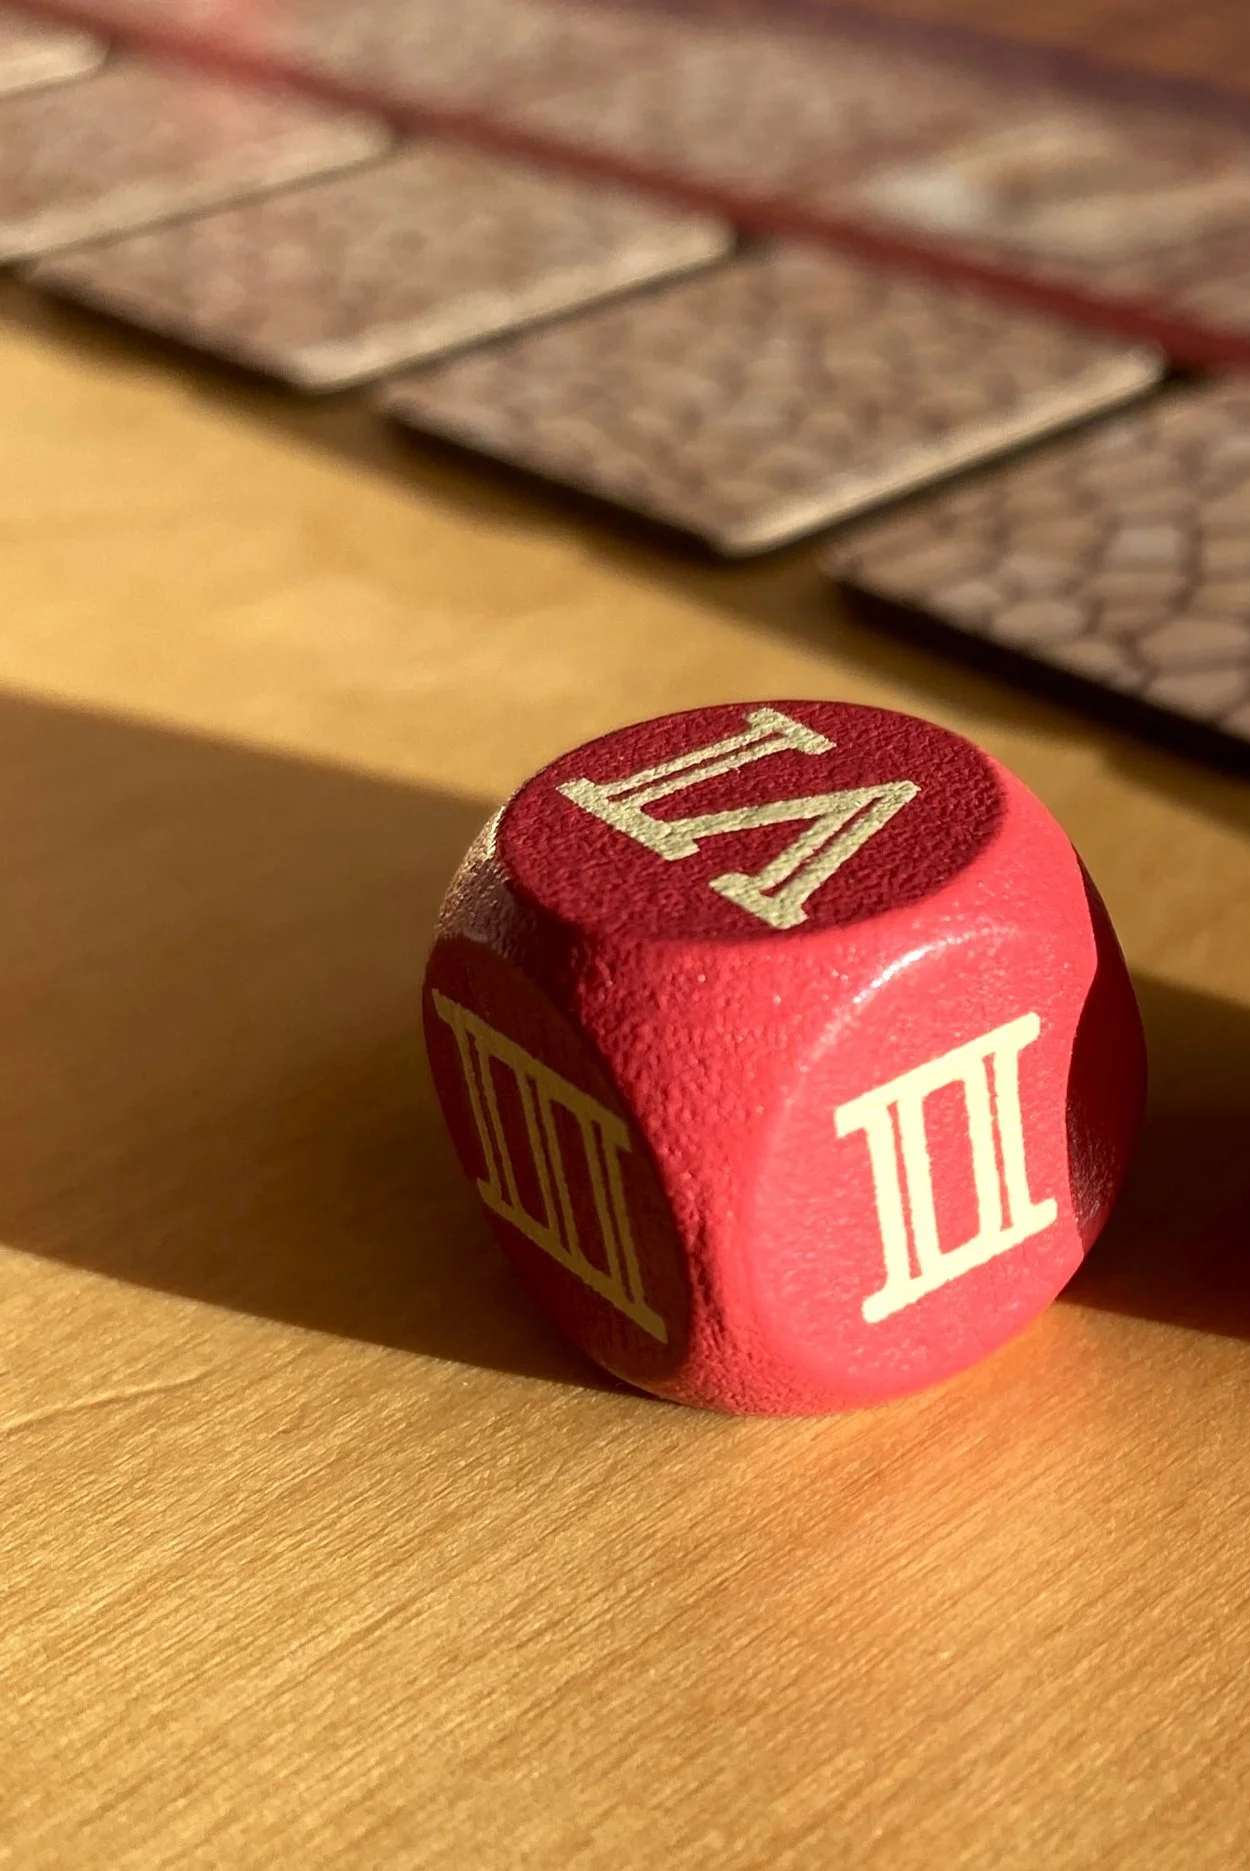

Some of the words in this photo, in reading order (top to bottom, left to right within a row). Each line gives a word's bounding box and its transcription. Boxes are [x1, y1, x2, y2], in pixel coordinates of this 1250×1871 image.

[555, 706, 921, 930] VI
[430, 988, 668, 1344] III
[834, 1011, 1058, 1324] II
